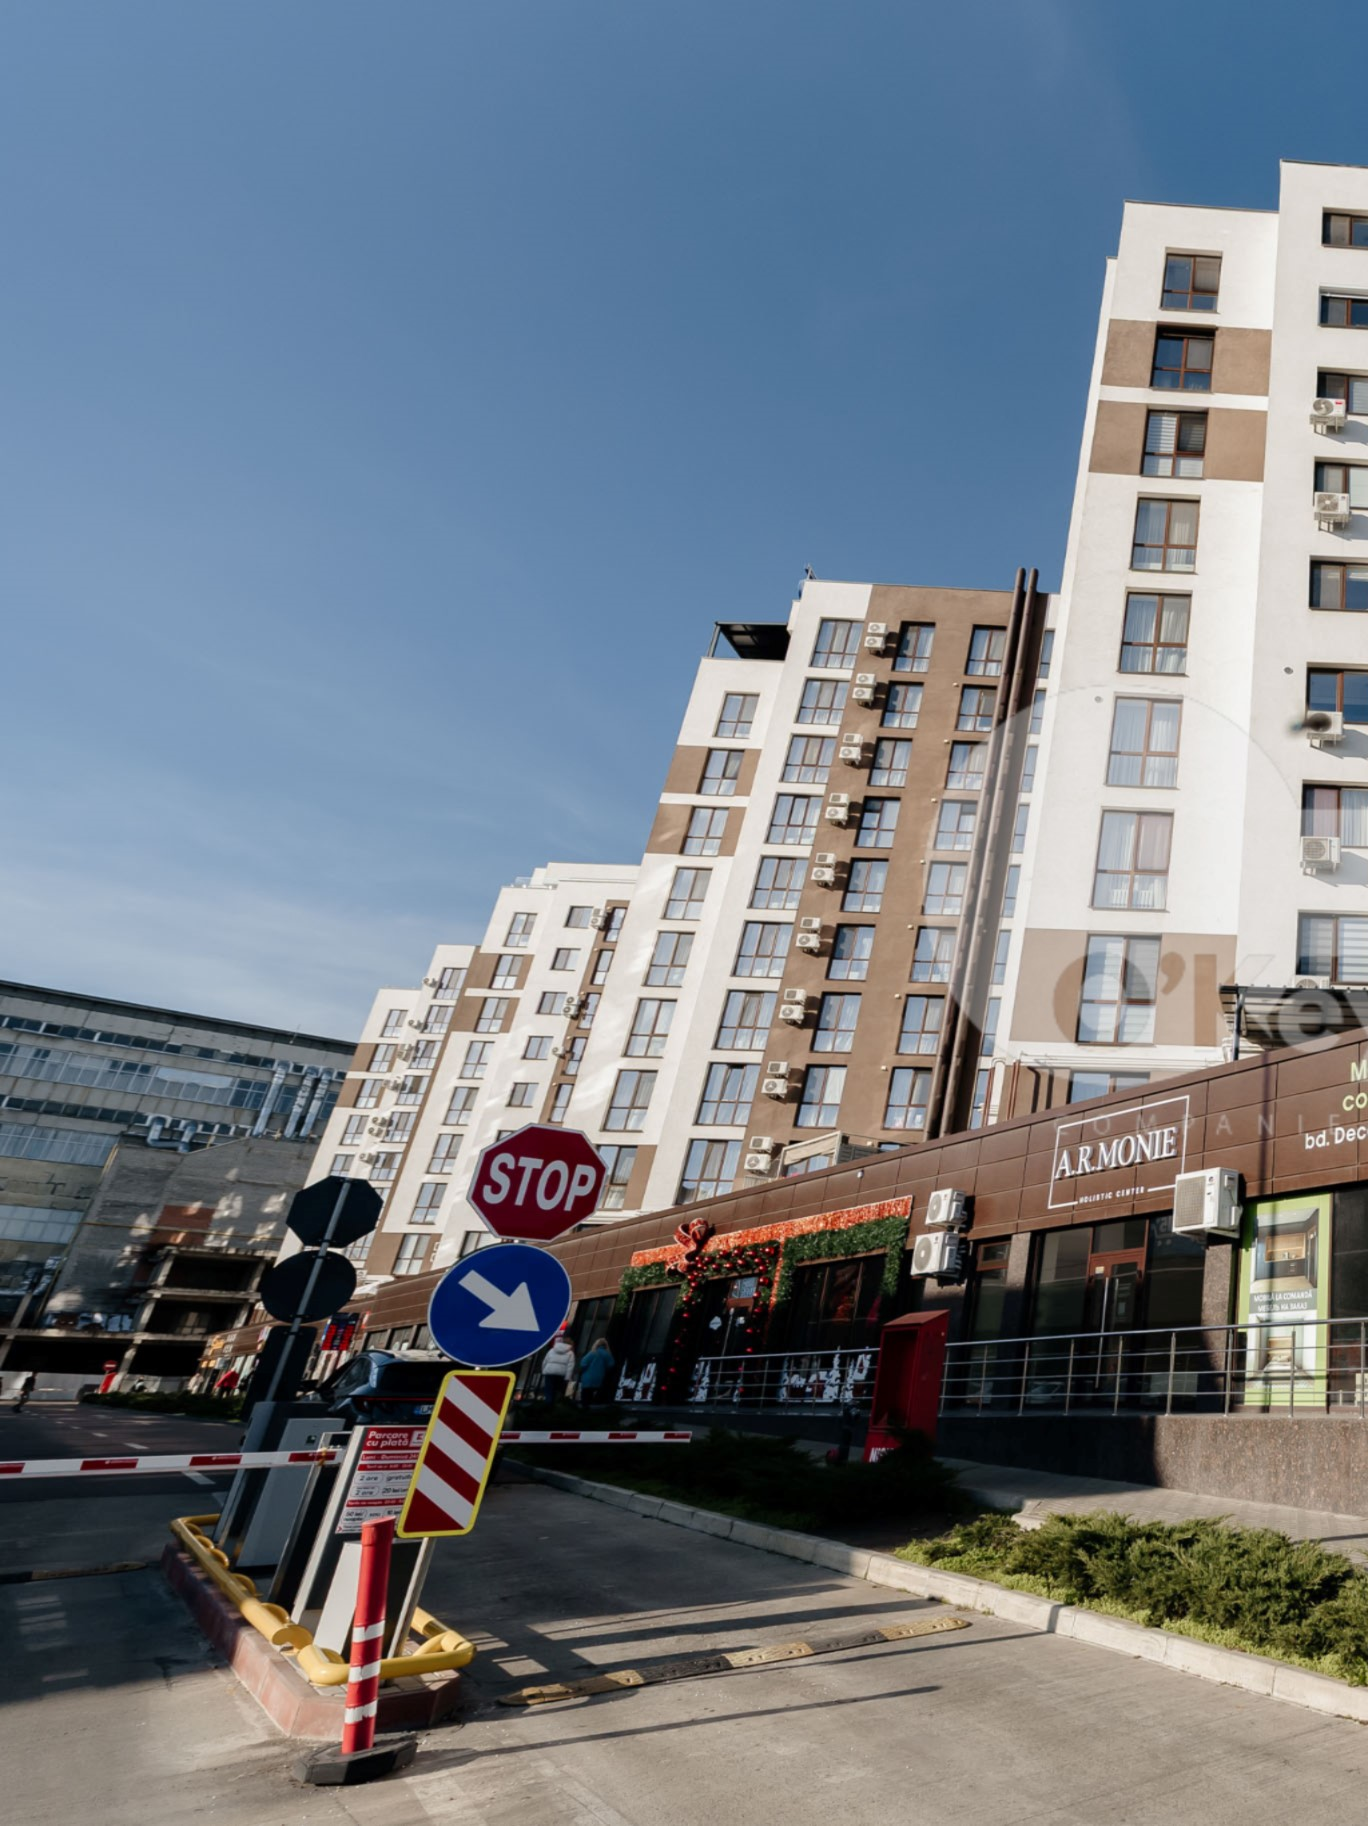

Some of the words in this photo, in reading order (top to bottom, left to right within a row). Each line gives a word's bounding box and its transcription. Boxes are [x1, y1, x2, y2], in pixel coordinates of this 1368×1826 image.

[1305, 1130, 1330, 1150] bd.
[1054, 1126, 1178, 1179] A.R.MONIE
[482, 1152, 597, 1211] STOP
[1079, 1191, 1113, 1204] HOLISTIC
[1116, 1186, 1145, 1198] CENTER
[369, 1430, 409, 1439] Parcare
